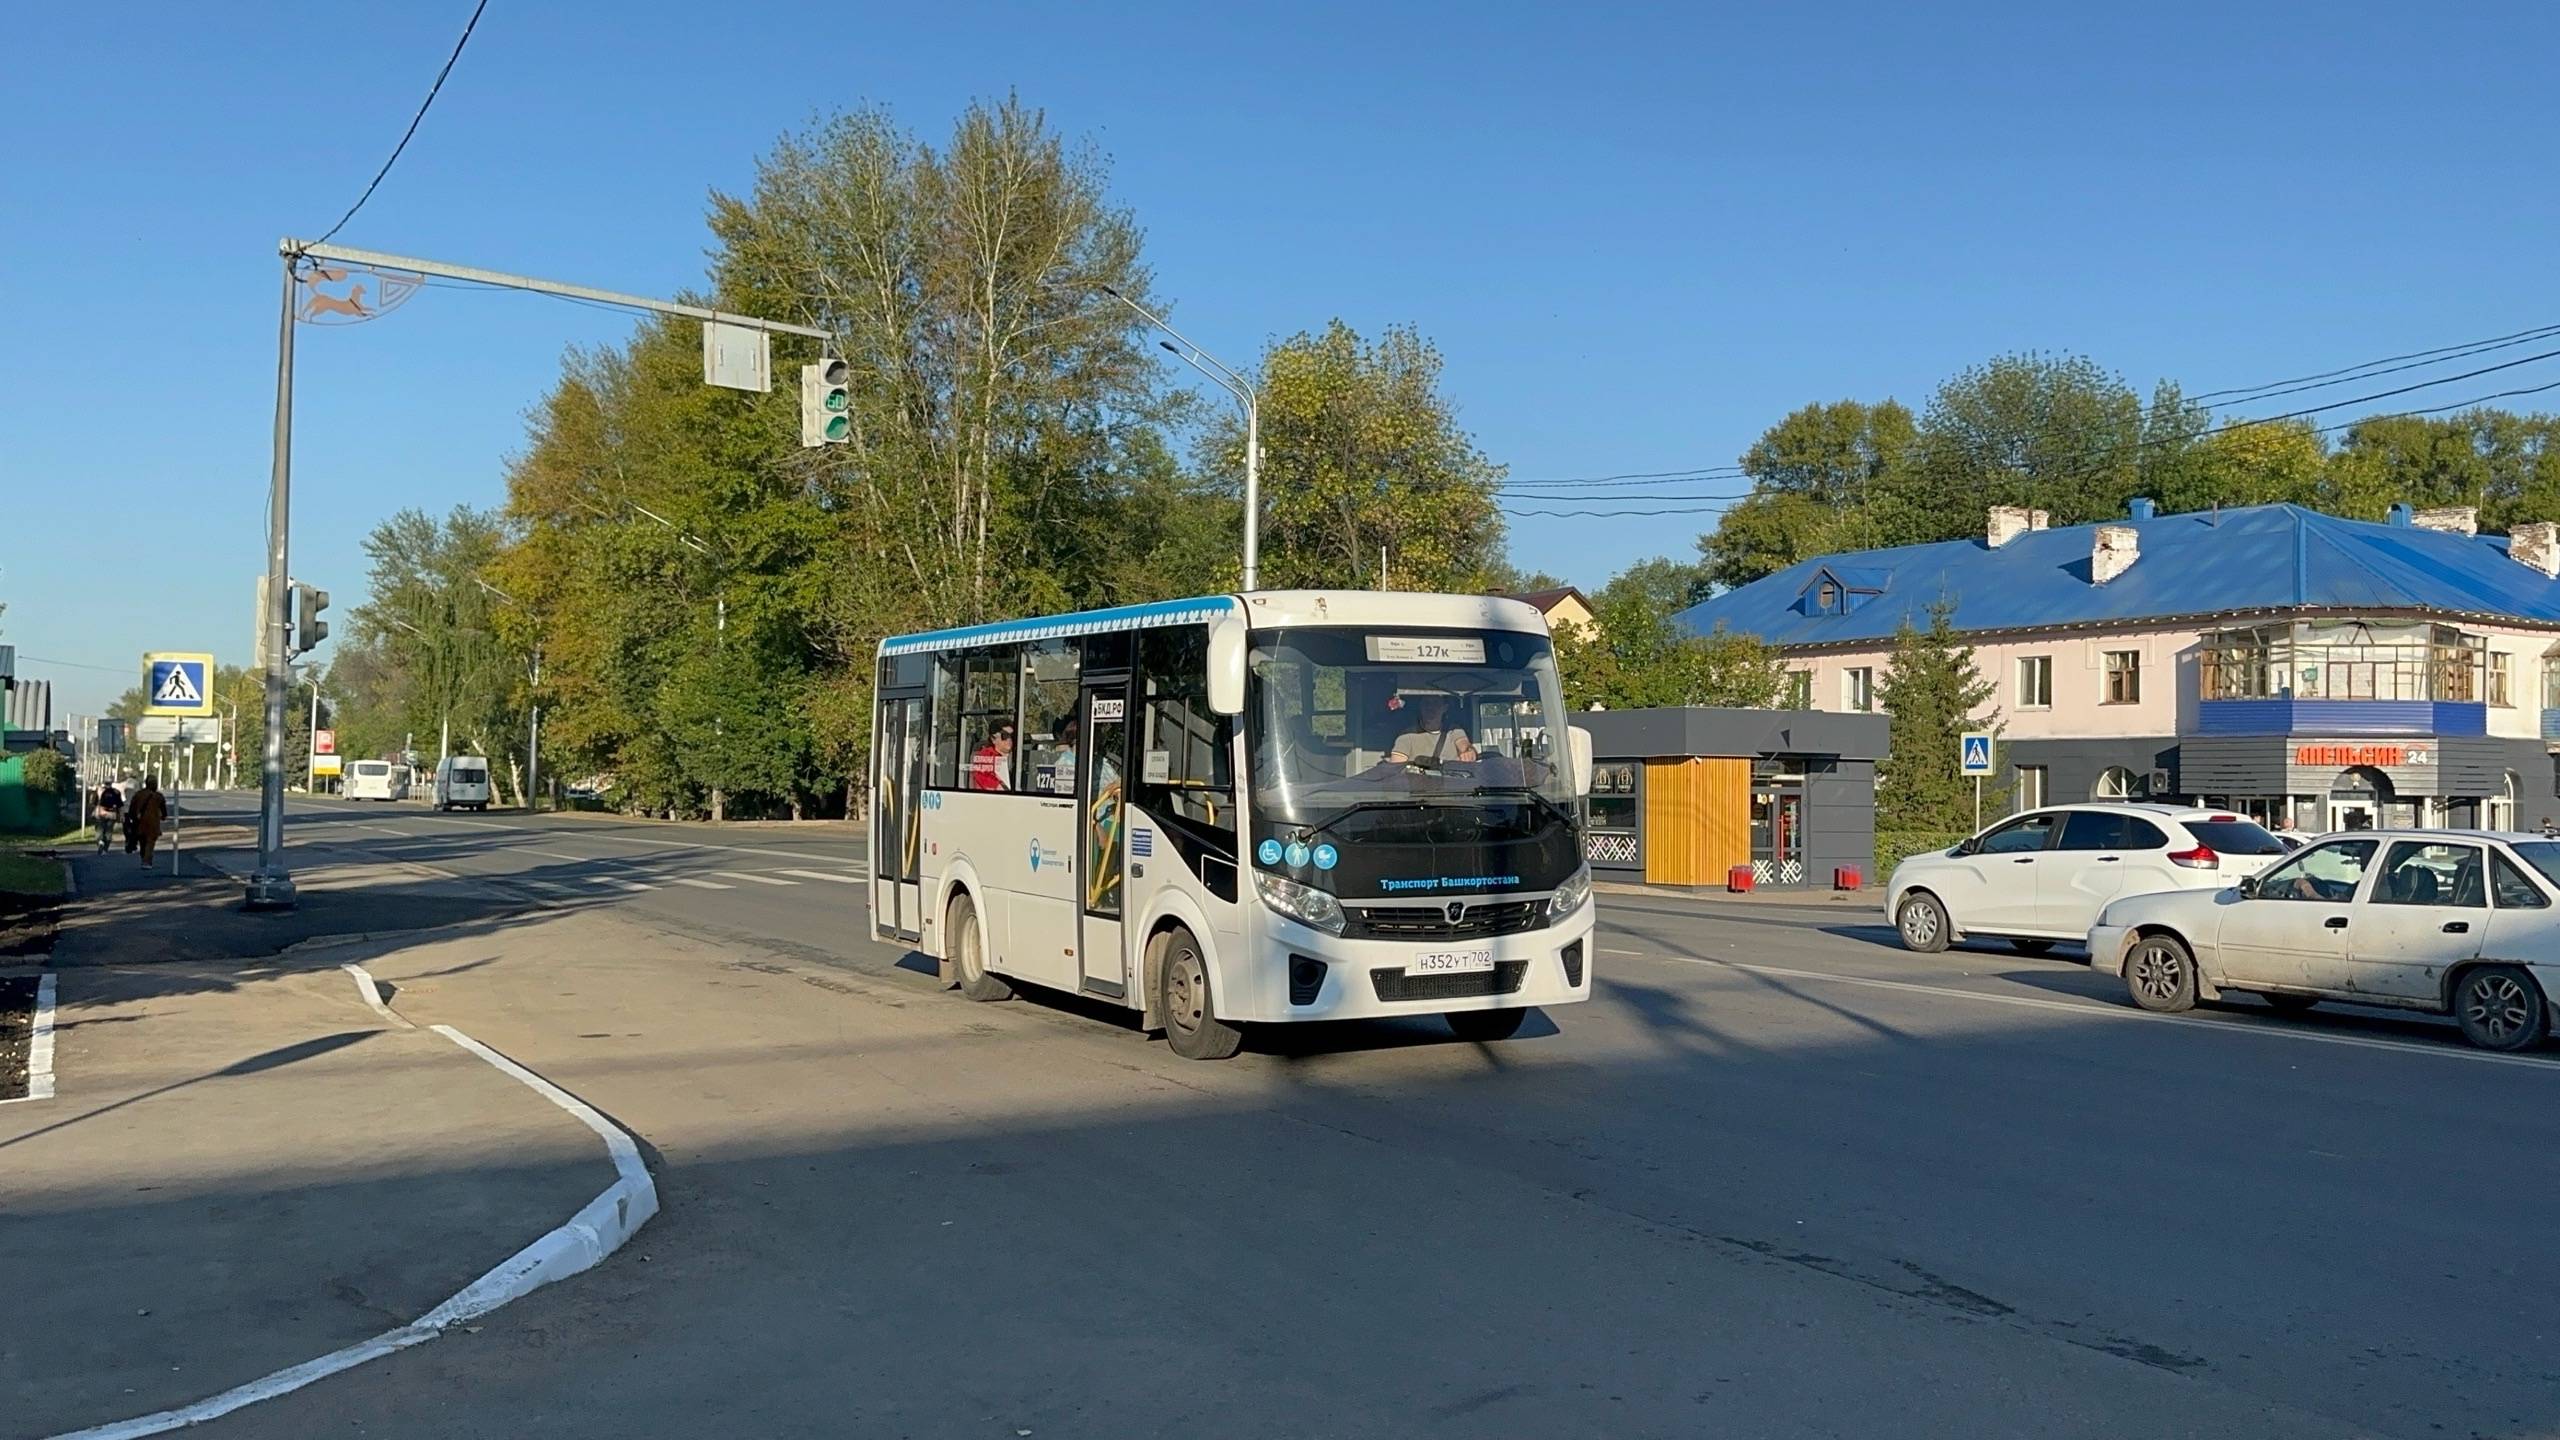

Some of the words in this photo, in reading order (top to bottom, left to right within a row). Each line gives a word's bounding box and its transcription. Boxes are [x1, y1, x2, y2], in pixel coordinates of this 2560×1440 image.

[2296, 746, 2402, 766] АПЕЛЬСИН
[2407, 750, 2428, 764] 24
[1380, 879, 1439, 891] Транспорт
[1441, 876, 1520, 887] Башкортостана
[1420, 954, 1469, 970] Н352УТ
[1471, 951, 1491, 963] 702
